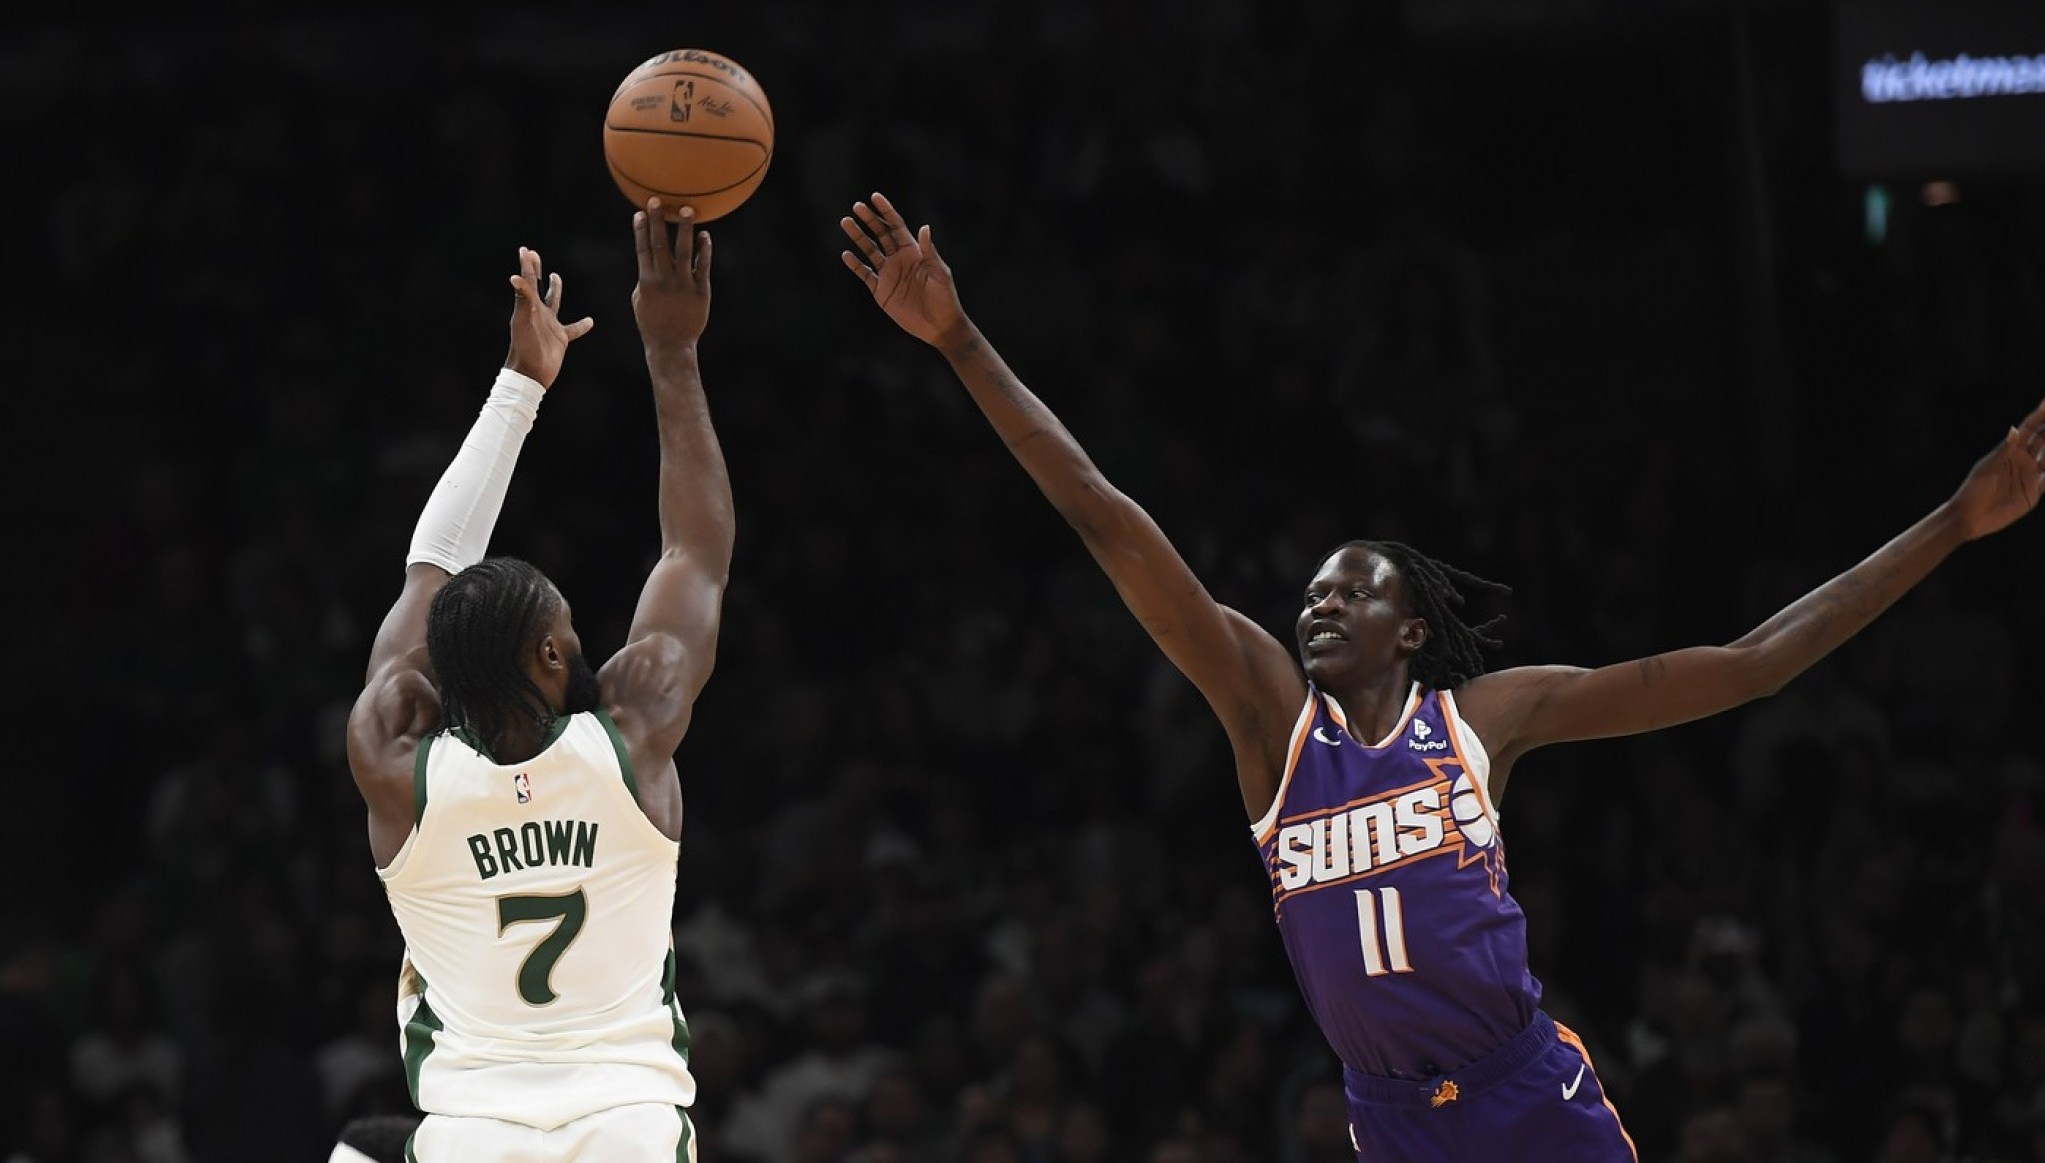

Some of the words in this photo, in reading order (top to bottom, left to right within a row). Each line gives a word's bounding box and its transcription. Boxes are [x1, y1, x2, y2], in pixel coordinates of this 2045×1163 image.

[1408, 738, 1448, 752] PayPal
[467, 820, 599, 880] BROWN
[495, 885, 589, 1008] 7
[1353, 886, 1415, 977] 11
